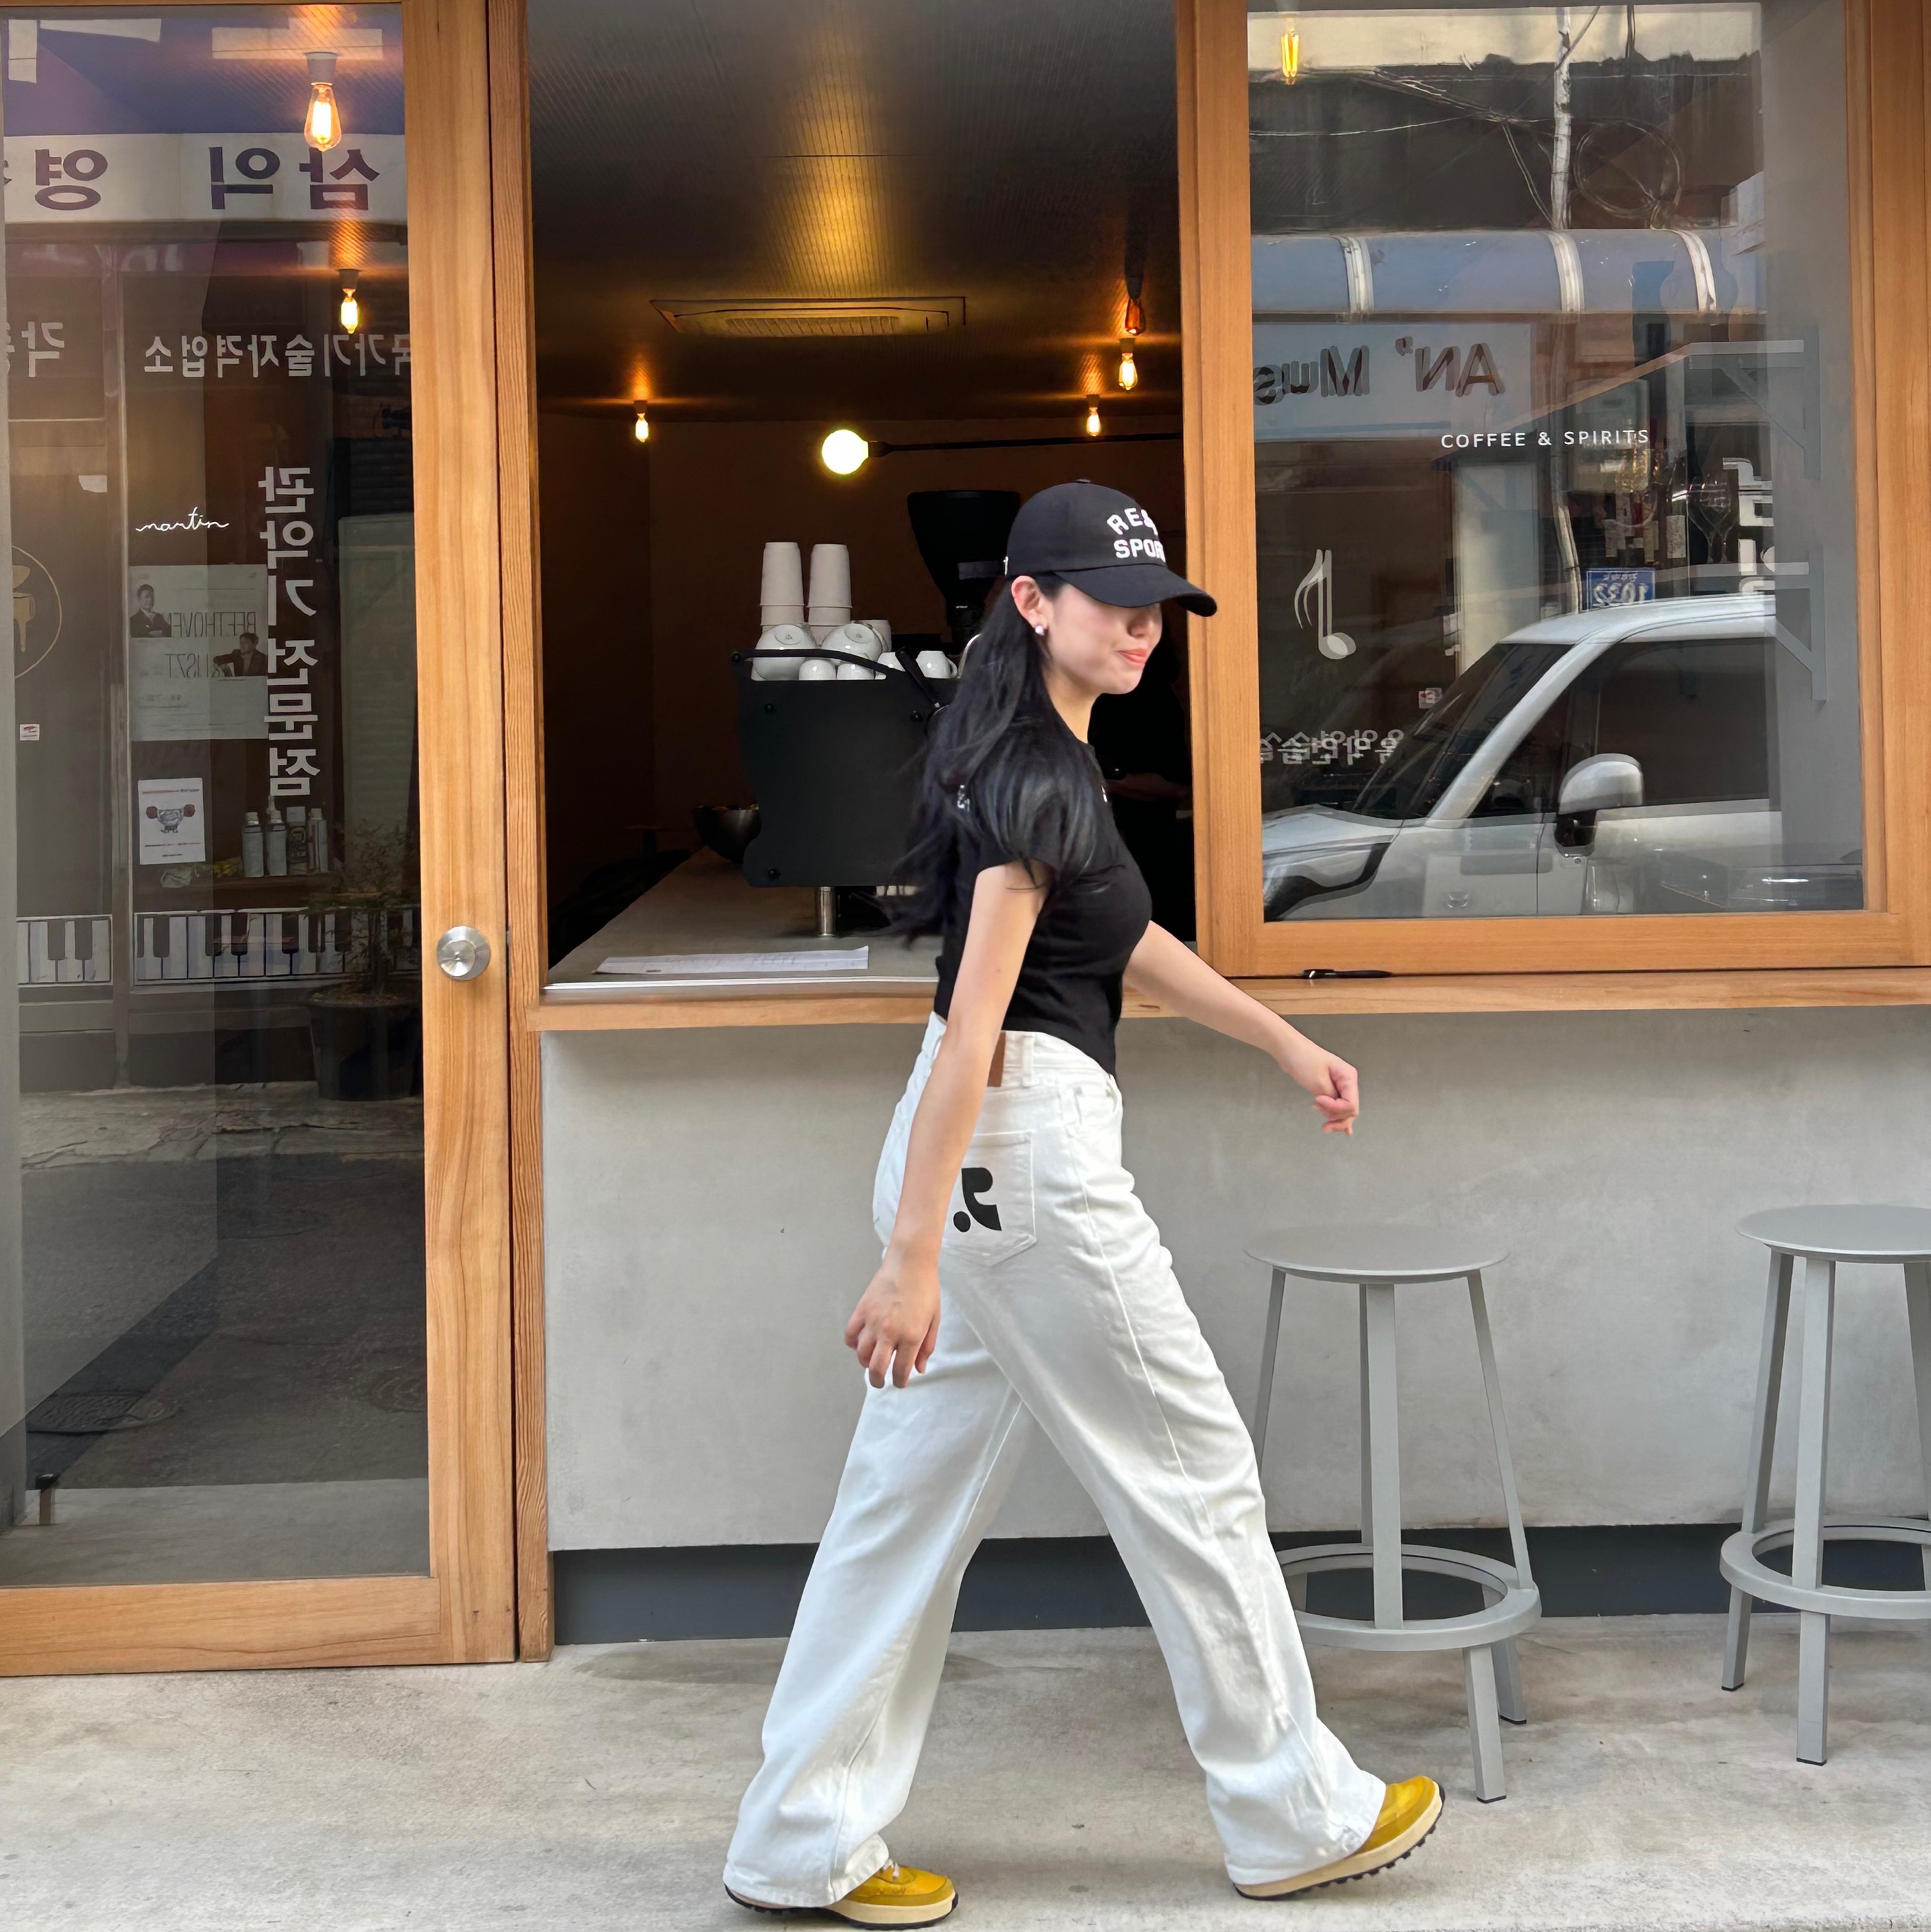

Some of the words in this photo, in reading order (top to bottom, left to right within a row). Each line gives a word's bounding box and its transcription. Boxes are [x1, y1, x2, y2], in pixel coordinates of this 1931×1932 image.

[1440, 431, 1527, 449] COFFEE
[1537, 431, 1553, 447] &
[1563, 429, 1649, 446] SPIRITS
